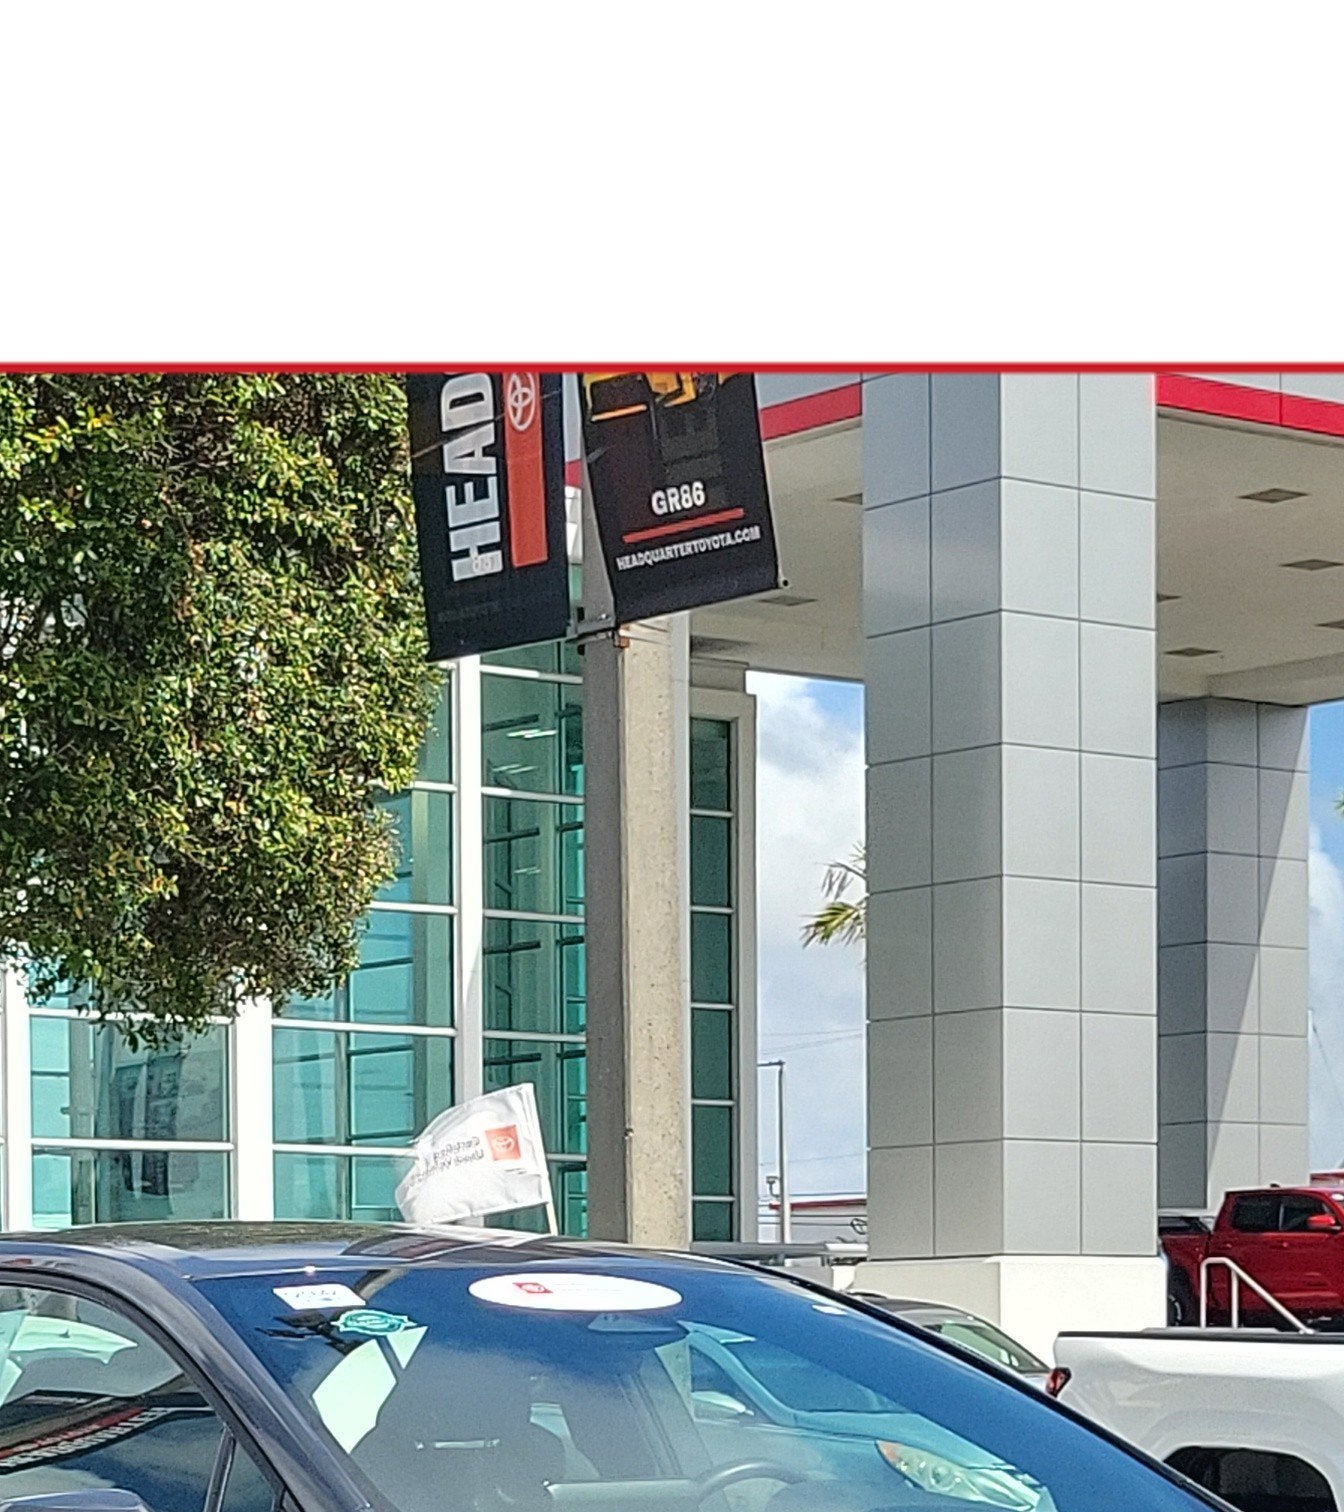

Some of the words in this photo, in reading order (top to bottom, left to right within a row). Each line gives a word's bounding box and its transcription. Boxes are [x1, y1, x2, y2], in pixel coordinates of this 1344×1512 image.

[441, 372, 503, 582] HEAD
[651, 481, 706, 515] GR86
[616, 525, 761, 571] HEADQUARTERTOYOTA.COM
